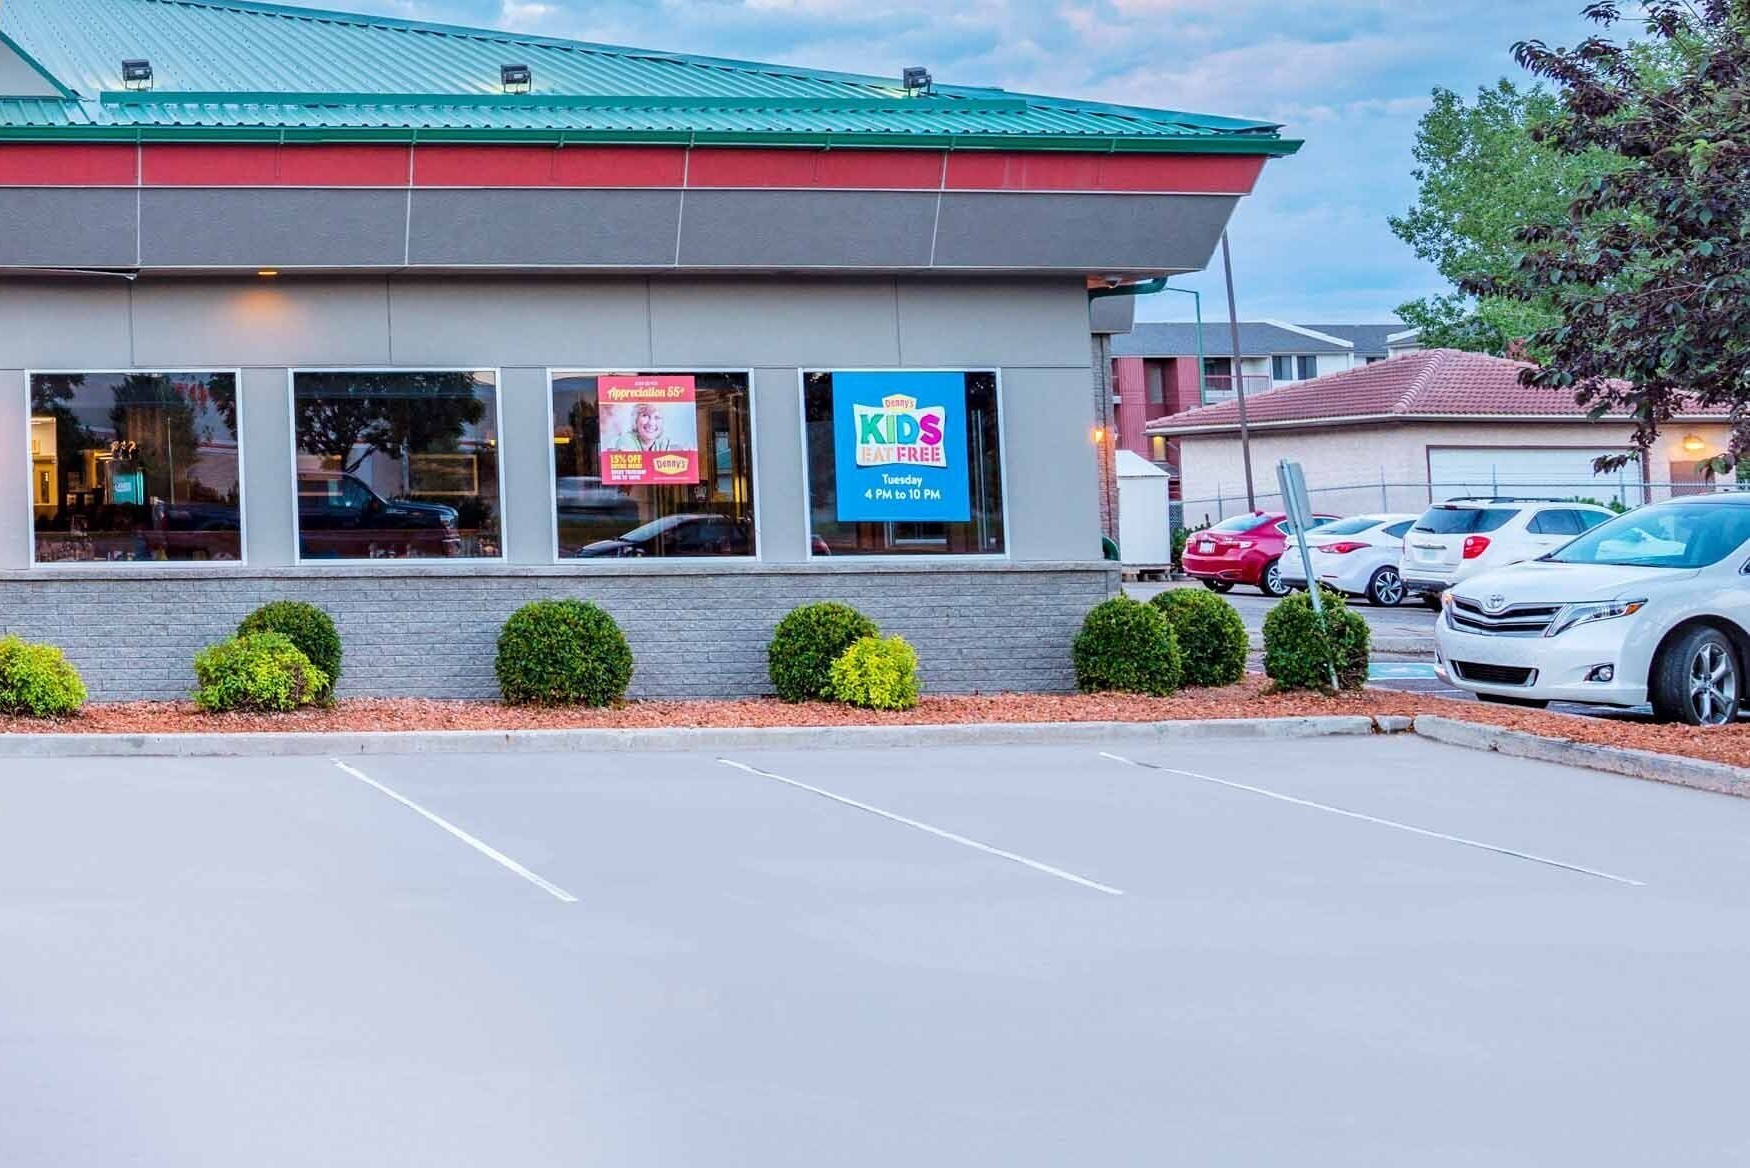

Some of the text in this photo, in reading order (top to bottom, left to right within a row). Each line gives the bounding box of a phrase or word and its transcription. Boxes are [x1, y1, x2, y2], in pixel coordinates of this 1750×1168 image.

[607, 386, 666, 401] Appreciation
[884, 399, 915, 409] Denny's
[859, 413, 942, 445] KIDS
[861, 446, 941, 462] EAT FREE
[655, 459, 686, 469] Denny's
[882, 473, 923, 488] Tuesday
[865, 488, 941, 500] 4 PM to 10 PM
